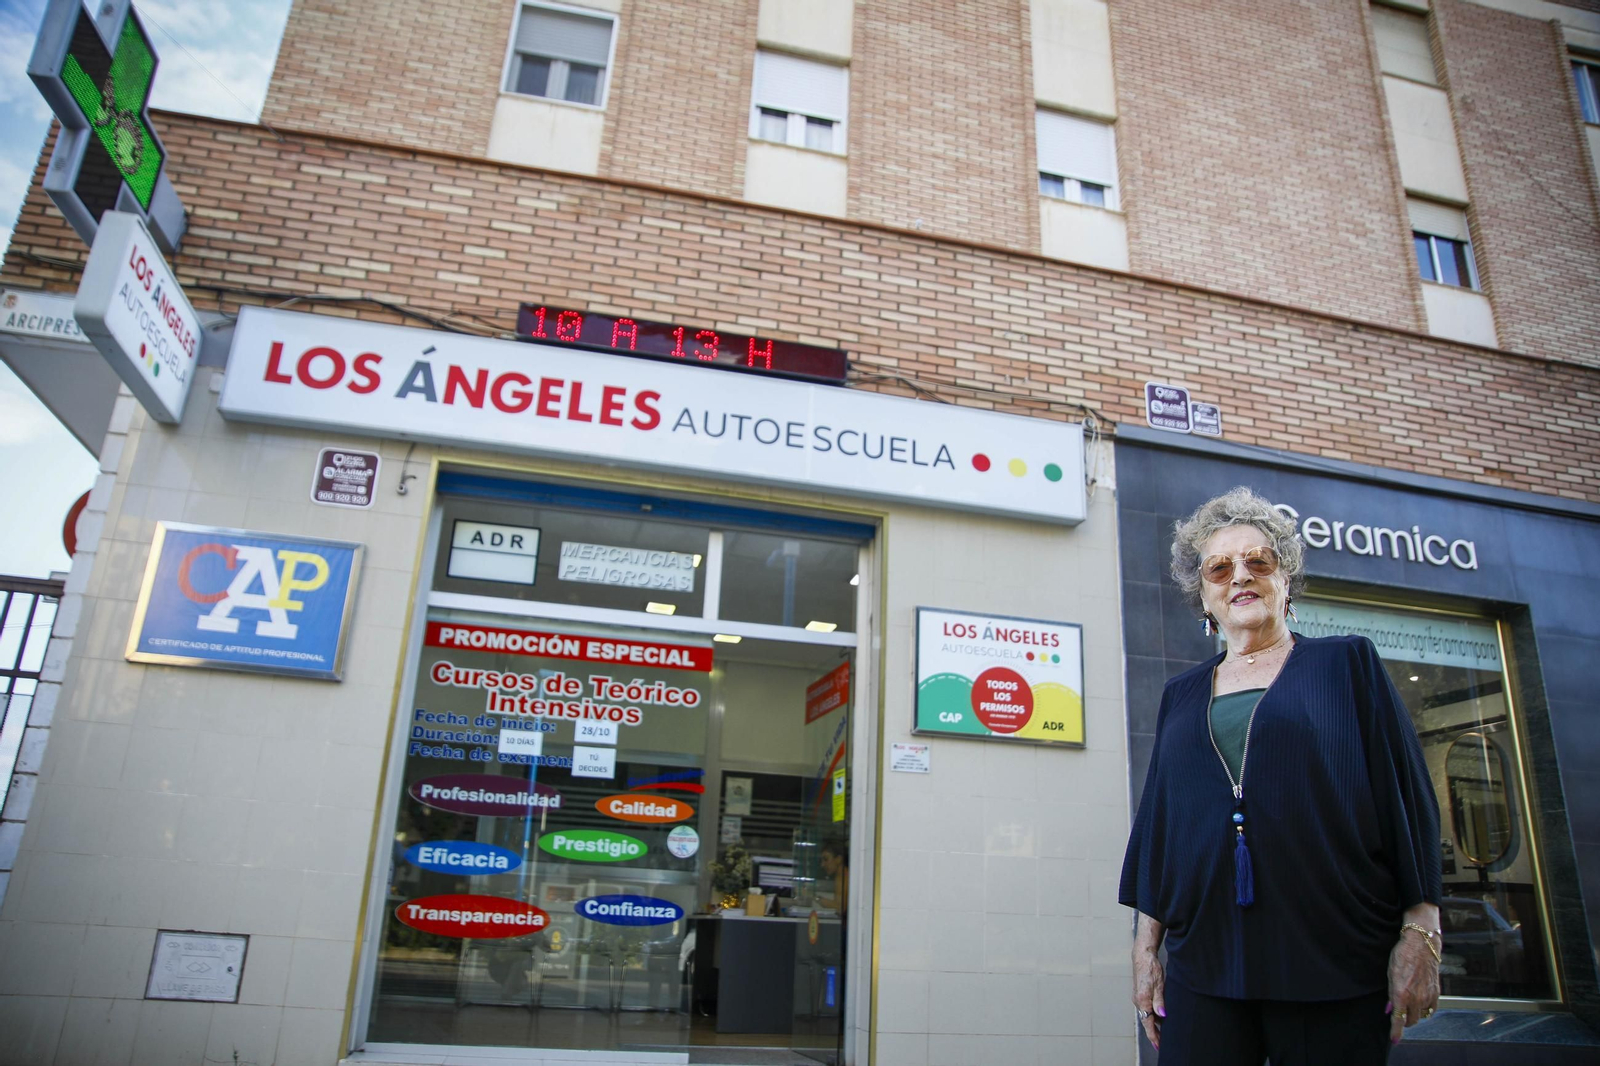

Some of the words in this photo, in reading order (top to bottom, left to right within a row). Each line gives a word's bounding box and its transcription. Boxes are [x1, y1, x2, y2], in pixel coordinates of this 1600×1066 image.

[128, 244, 154, 292] LOS
[152, 278, 196, 358] ÁNGELES
[118, 282, 188, 385] AUTOESCUELA
[532, 307, 583, 341] 10
[611, 318, 638, 350] A
[671, 327, 719, 361] 13
[748, 337, 774, 369] H
[263, 341, 384, 394] LOS
[394, 345, 661, 431] ÁNGELES
[672, 407, 956, 470] AUTOESCUELA
[470, 530, 524, 549] ADR
[562, 542, 695, 570] MERCANCIAS
[562, 563, 692, 590] PELIGROSAS
[177, 543, 330, 639] CAP
[943, 622, 977, 639] LOS
[982, 621, 1060, 648] ÁNGELES
[148, 637, 208, 650] CERTIFICADO
[209, 643, 222, 651] DE
[224, 644, 261, 655] APTITUD
[262, 648, 325, 662] PROFESIONAL
[438, 626, 580, 657] PROMOCIÓN
[586, 641, 696, 667] ESPECIAL
[941, 643, 1024, 660] AUTOESCUELA
[430, 660, 537, 692] Cursos
[543, 672, 581, 696] de
[590, 674, 701, 707] Teórico
[986, 679, 1018, 691] TODOS
[993, 692, 1012, 702] LOS
[486, 691, 643, 726] Intensivos
[938, 711, 963, 724] CAP
[980, 702, 1026, 715] PERMISOS
[414, 708, 469, 726] Fecha
[474, 713, 496, 728] de
[501, 716, 556, 732] inicio:
[1042, 720, 1065, 732] ADR
[412, 725, 499, 745] Duración:
[506, 737, 515, 746] 10
[516, 737, 535, 746] DÍAS
[581, 726, 610, 737] 28/10
[409, 742, 465, 760] Fecha
[469, 747, 493, 762] de
[589, 752, 599, 761] TÚ
[578, 765, 608, 774] DECIDES
[421, 784, 562, 808] Profesionalidad
[609, 799, 677, 818] Calidad
[552, 835, 640, 857] Prestigio
[418, 846, 509, 869] Eficacia
[407, 904, 545, 926] Transparencia
[584, 899, 676, 919] Confianza
